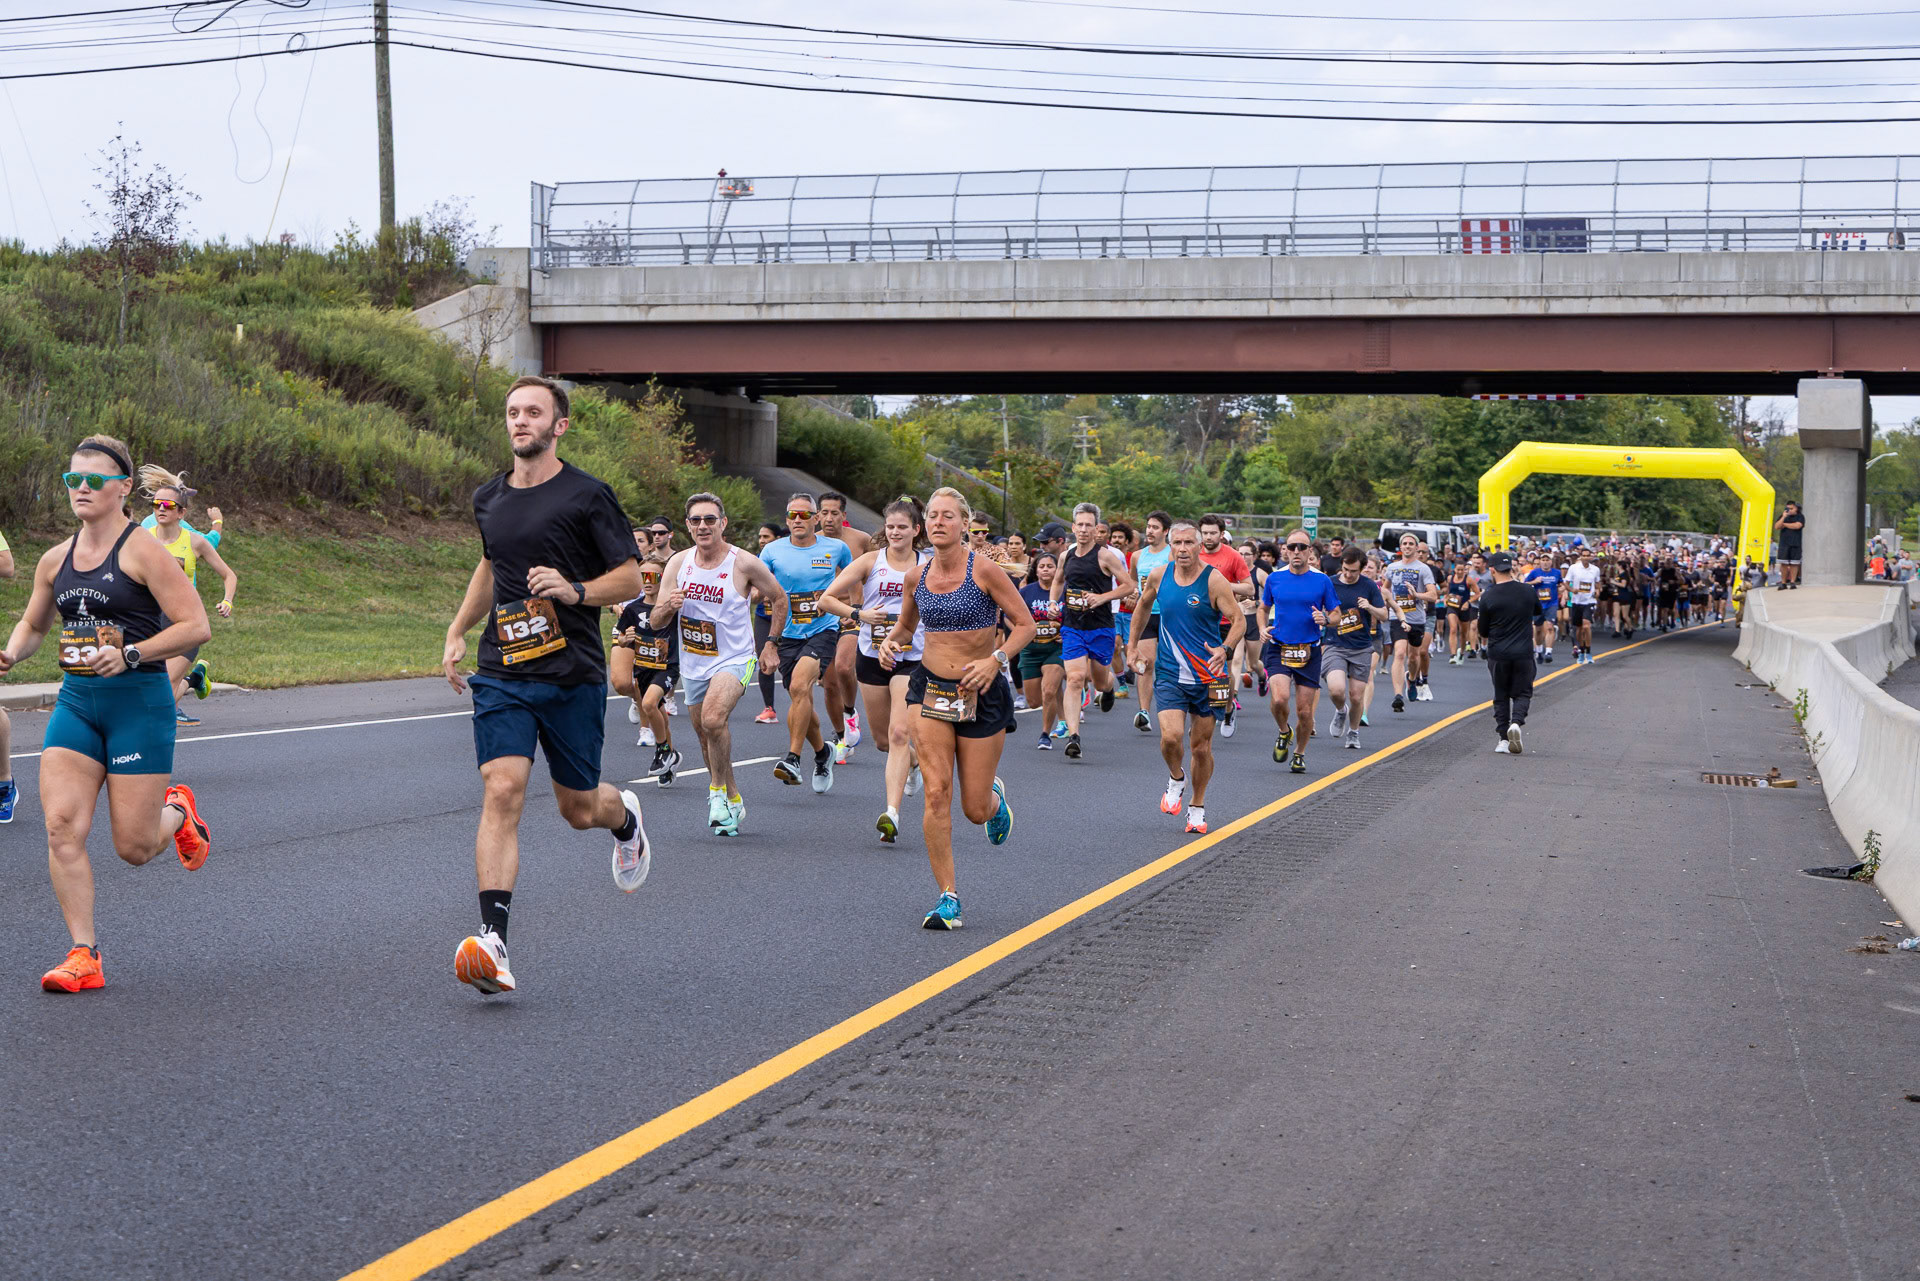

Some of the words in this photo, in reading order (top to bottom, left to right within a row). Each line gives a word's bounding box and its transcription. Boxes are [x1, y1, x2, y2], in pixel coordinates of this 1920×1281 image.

[879, 582, 904, 592] LEO
[57, 587, 110, 606] PRINCETON
[704, 595, 723, 604] CLUB
[497, 614, 517, 624] CHASE
[516, 611, 527, 619] 5K
[503, 615, 550, 641] 132
[1036, 627, 1057, 636] 103
[683, 628, 713, 644] 699
[63, 645, 117, 664] 33
[639, 645, 660, 657] 68
[1284, 649, 1307, 658] 219
[934, 697, 966, 712] 24
[112, 752, 142, 765] HOKA
